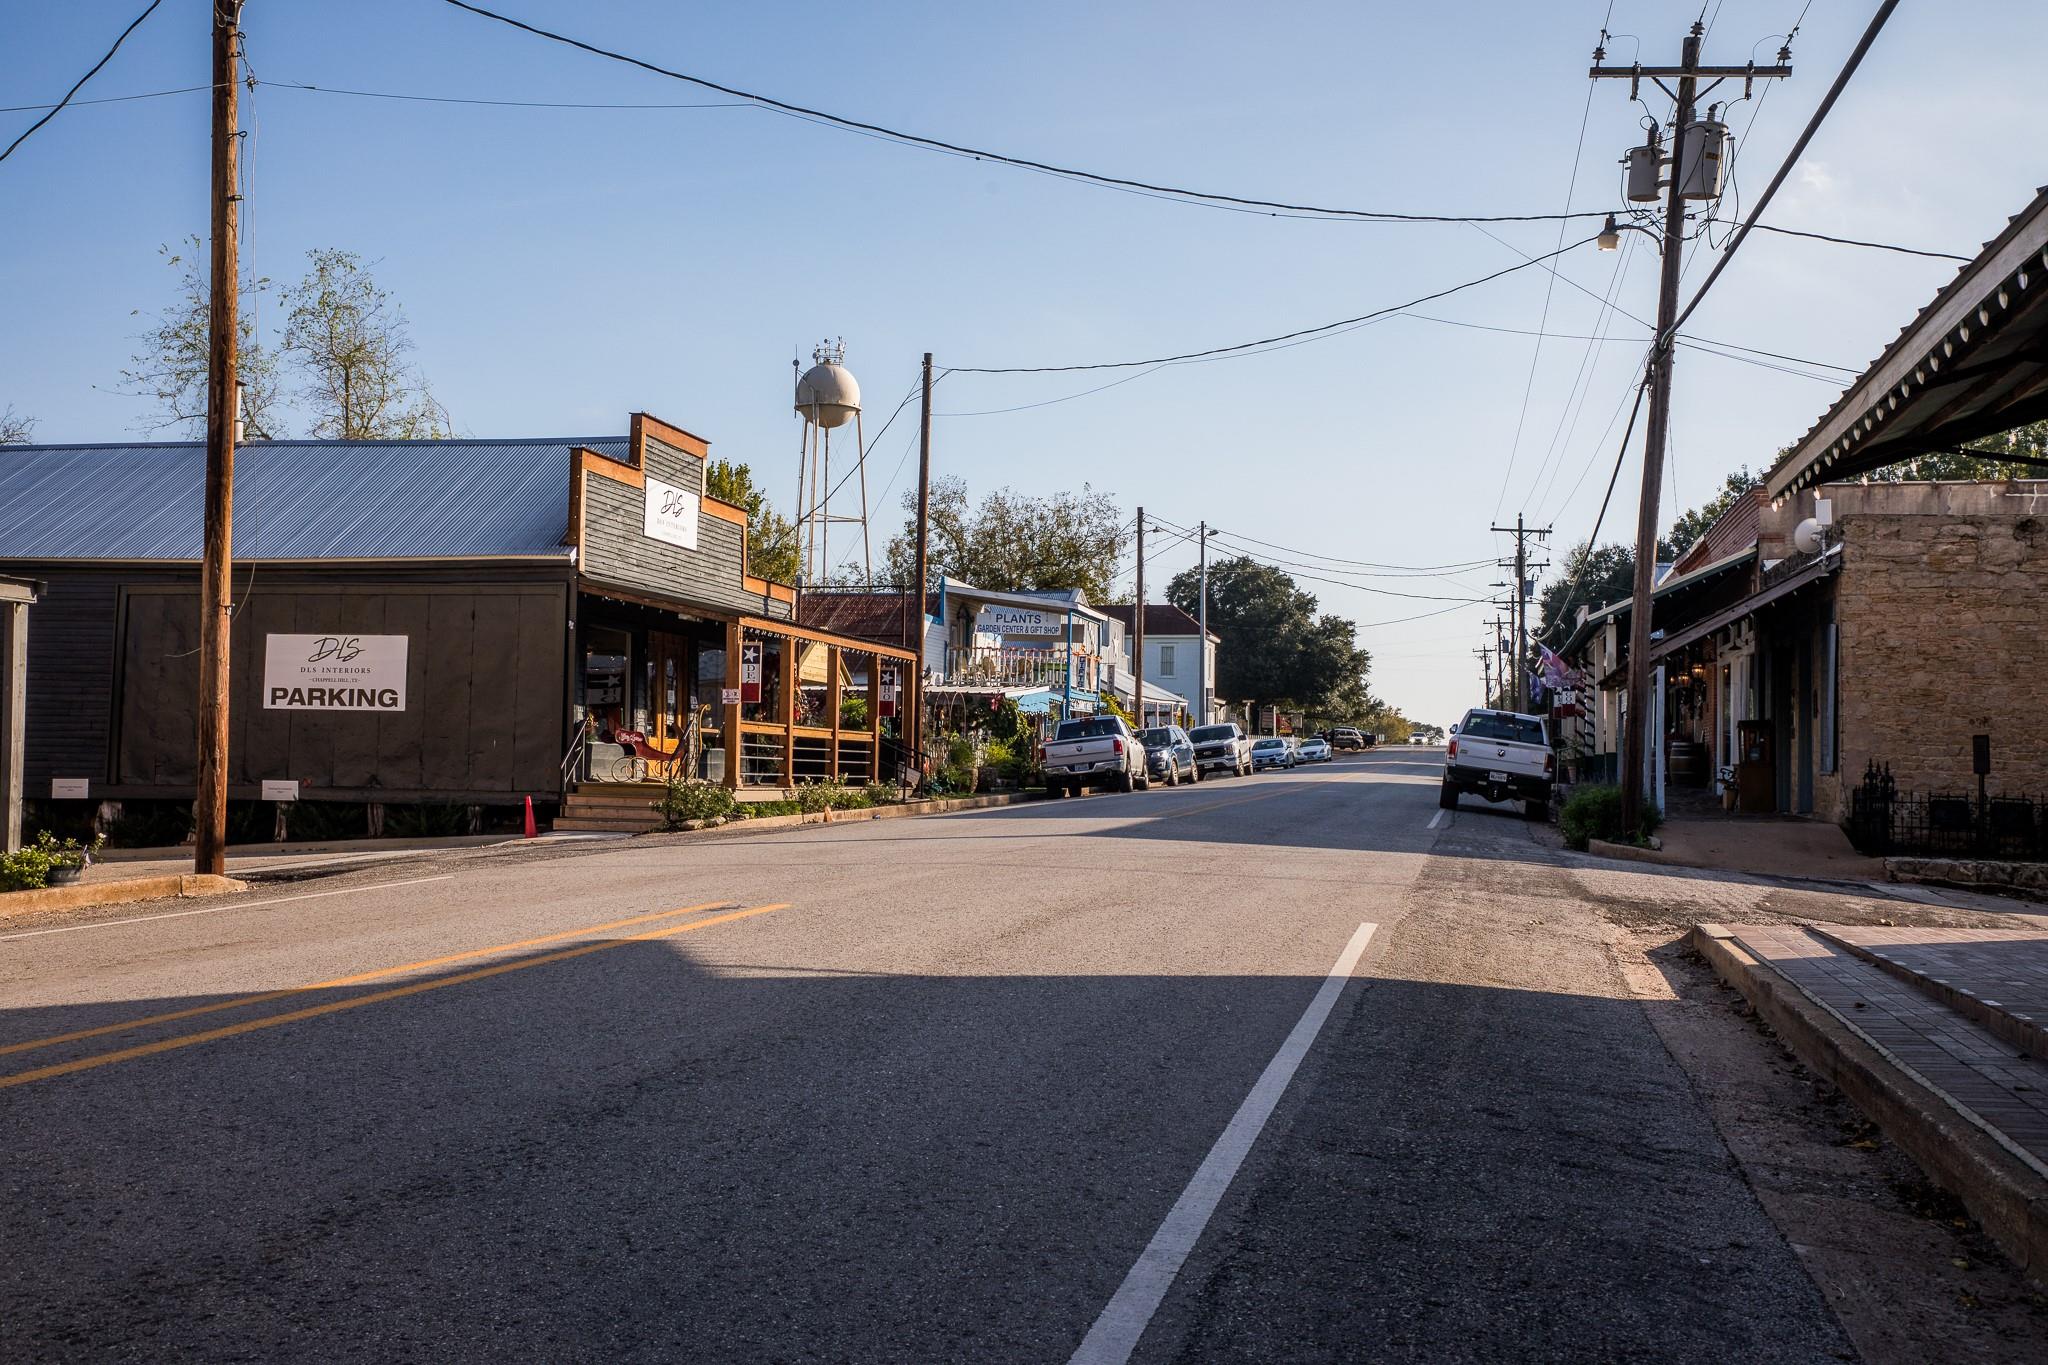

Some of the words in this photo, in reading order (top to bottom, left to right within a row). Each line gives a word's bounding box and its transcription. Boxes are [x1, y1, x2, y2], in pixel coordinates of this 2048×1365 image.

[995, 613, 1042, 624] PLANTS
[977, 624, 1000, 633] GARDEN
[1001, 625, 1024, 633] CENTER
[1030, 626, 1042, 634] GIFT
[1043, 626, 1060, 634] SHOP
[308, 636, 367, 662] DLS
[270, 687, 399, 708] PARKING
